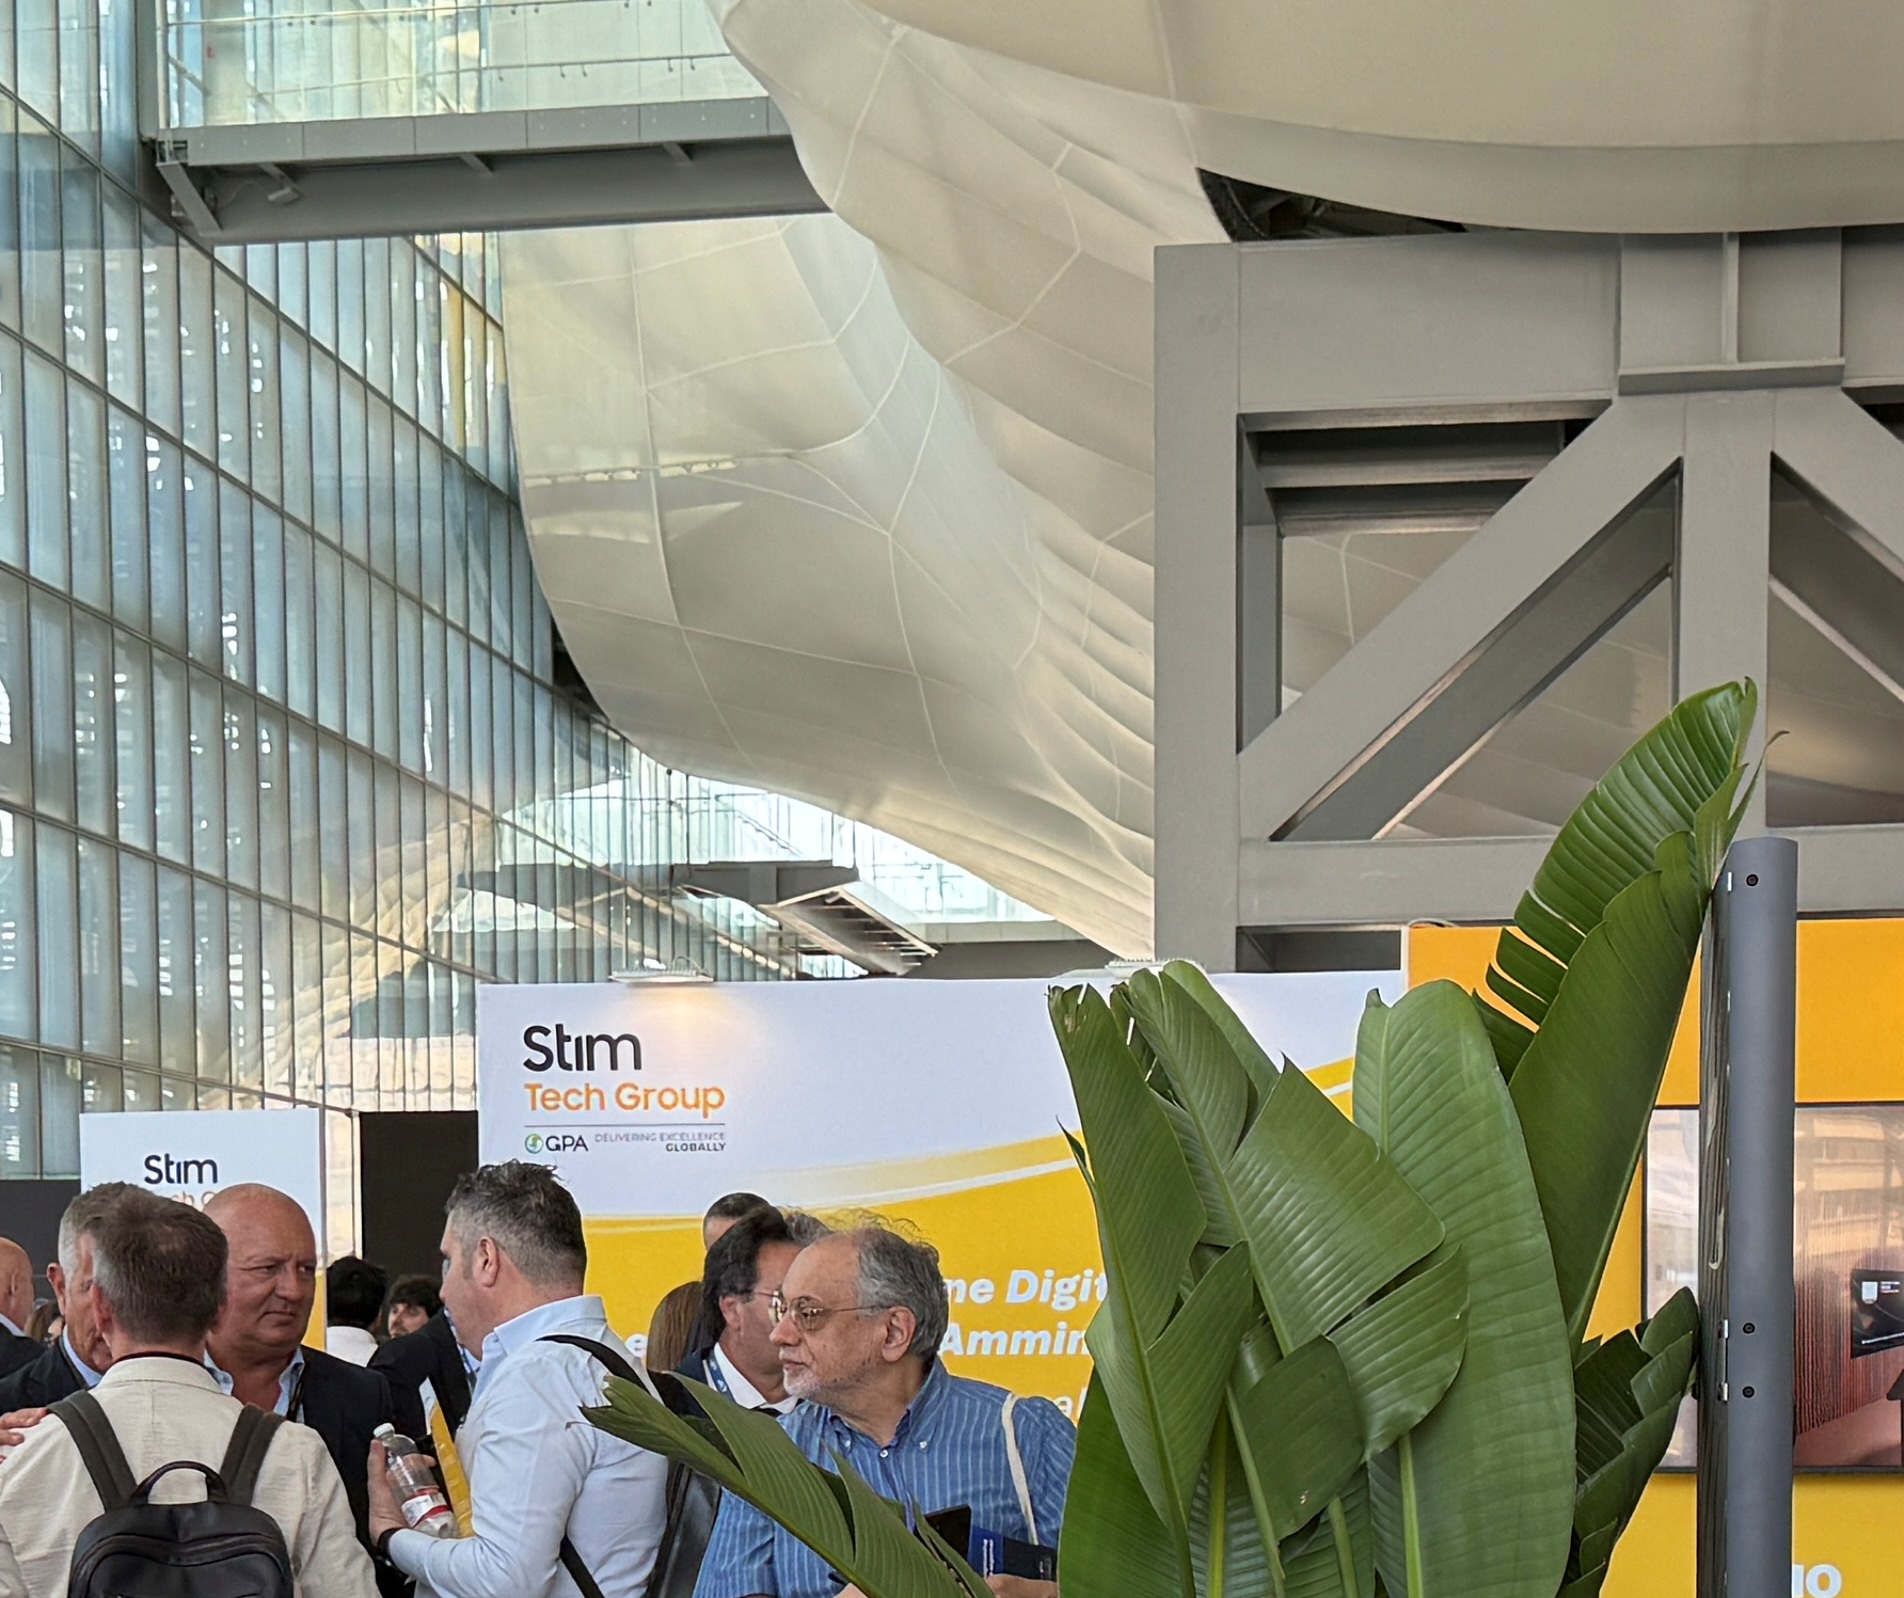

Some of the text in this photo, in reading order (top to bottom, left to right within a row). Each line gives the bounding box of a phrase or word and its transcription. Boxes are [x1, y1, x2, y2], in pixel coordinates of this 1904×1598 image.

[523, 1023, 642, 1072] Stim
[524, 1082, 726, 1119] Tech Group
[545, 1132, 726, 1152] GPA DELIVERING EXCELLENCE
[665, 1142, 727, 1153] GLOBALLY
[144, 1153, 218, 1185] Stim
[1006, 1268, 1108, 1312] Digit
[937, 1321, 1089, 1356] Ammin
